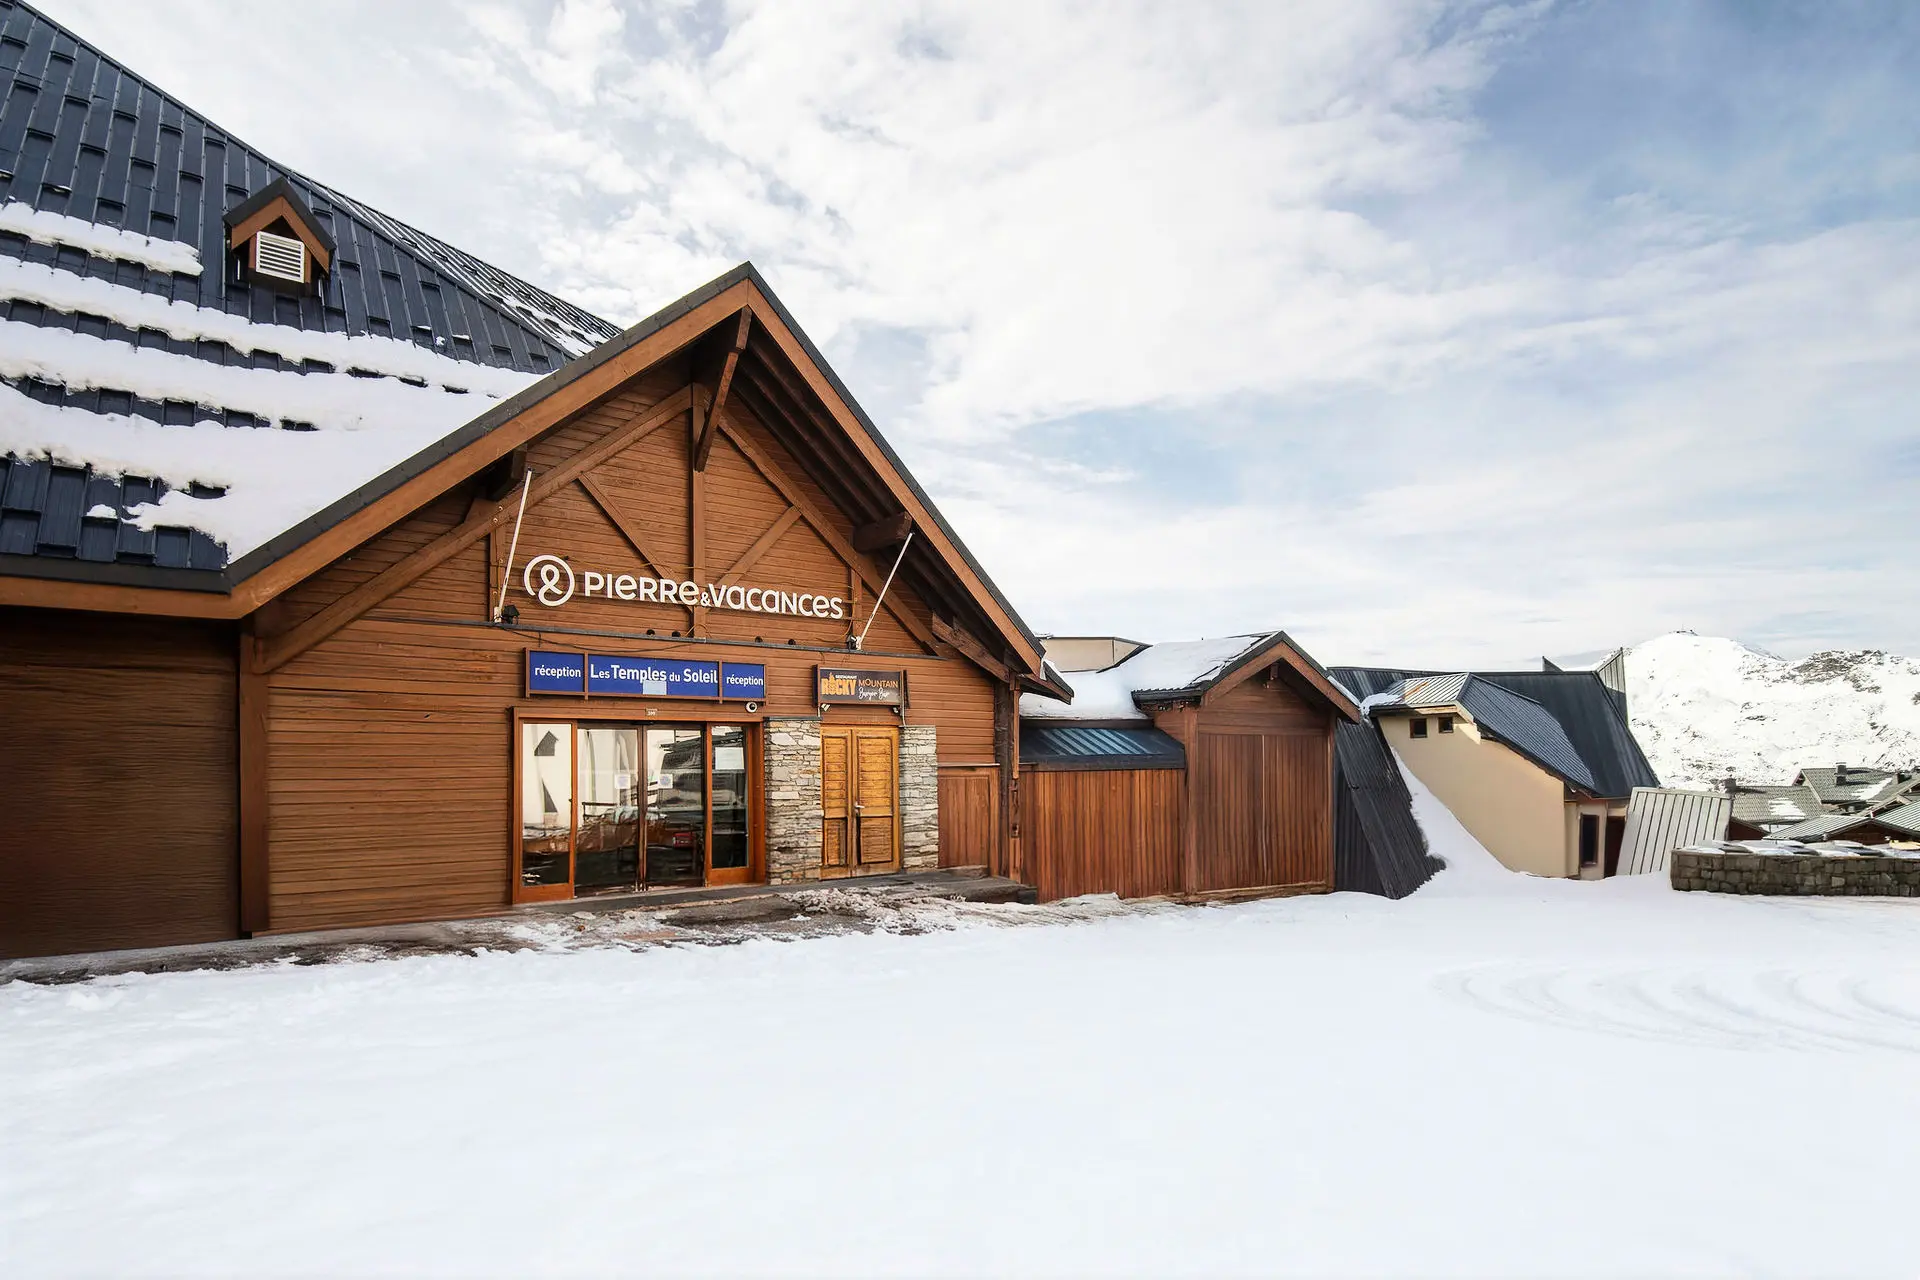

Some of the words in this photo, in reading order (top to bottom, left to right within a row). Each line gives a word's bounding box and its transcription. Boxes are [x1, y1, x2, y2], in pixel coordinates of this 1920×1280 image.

[534, 664, 582, 679] réception
[590, 663, 611, 679] Les
[611, 664, 668, 684] Temples
[669, 671, 681, 682] du
[683, 668, 719, 684] Soleil
[726, 673, 764, 687] réception
[821, 674, 856, 695] ROCKY
[858, 678, 898, 688] MOUNTAIN
[858, 687, 878, 700] Burger
[878, 687, 890, 699] Bar
